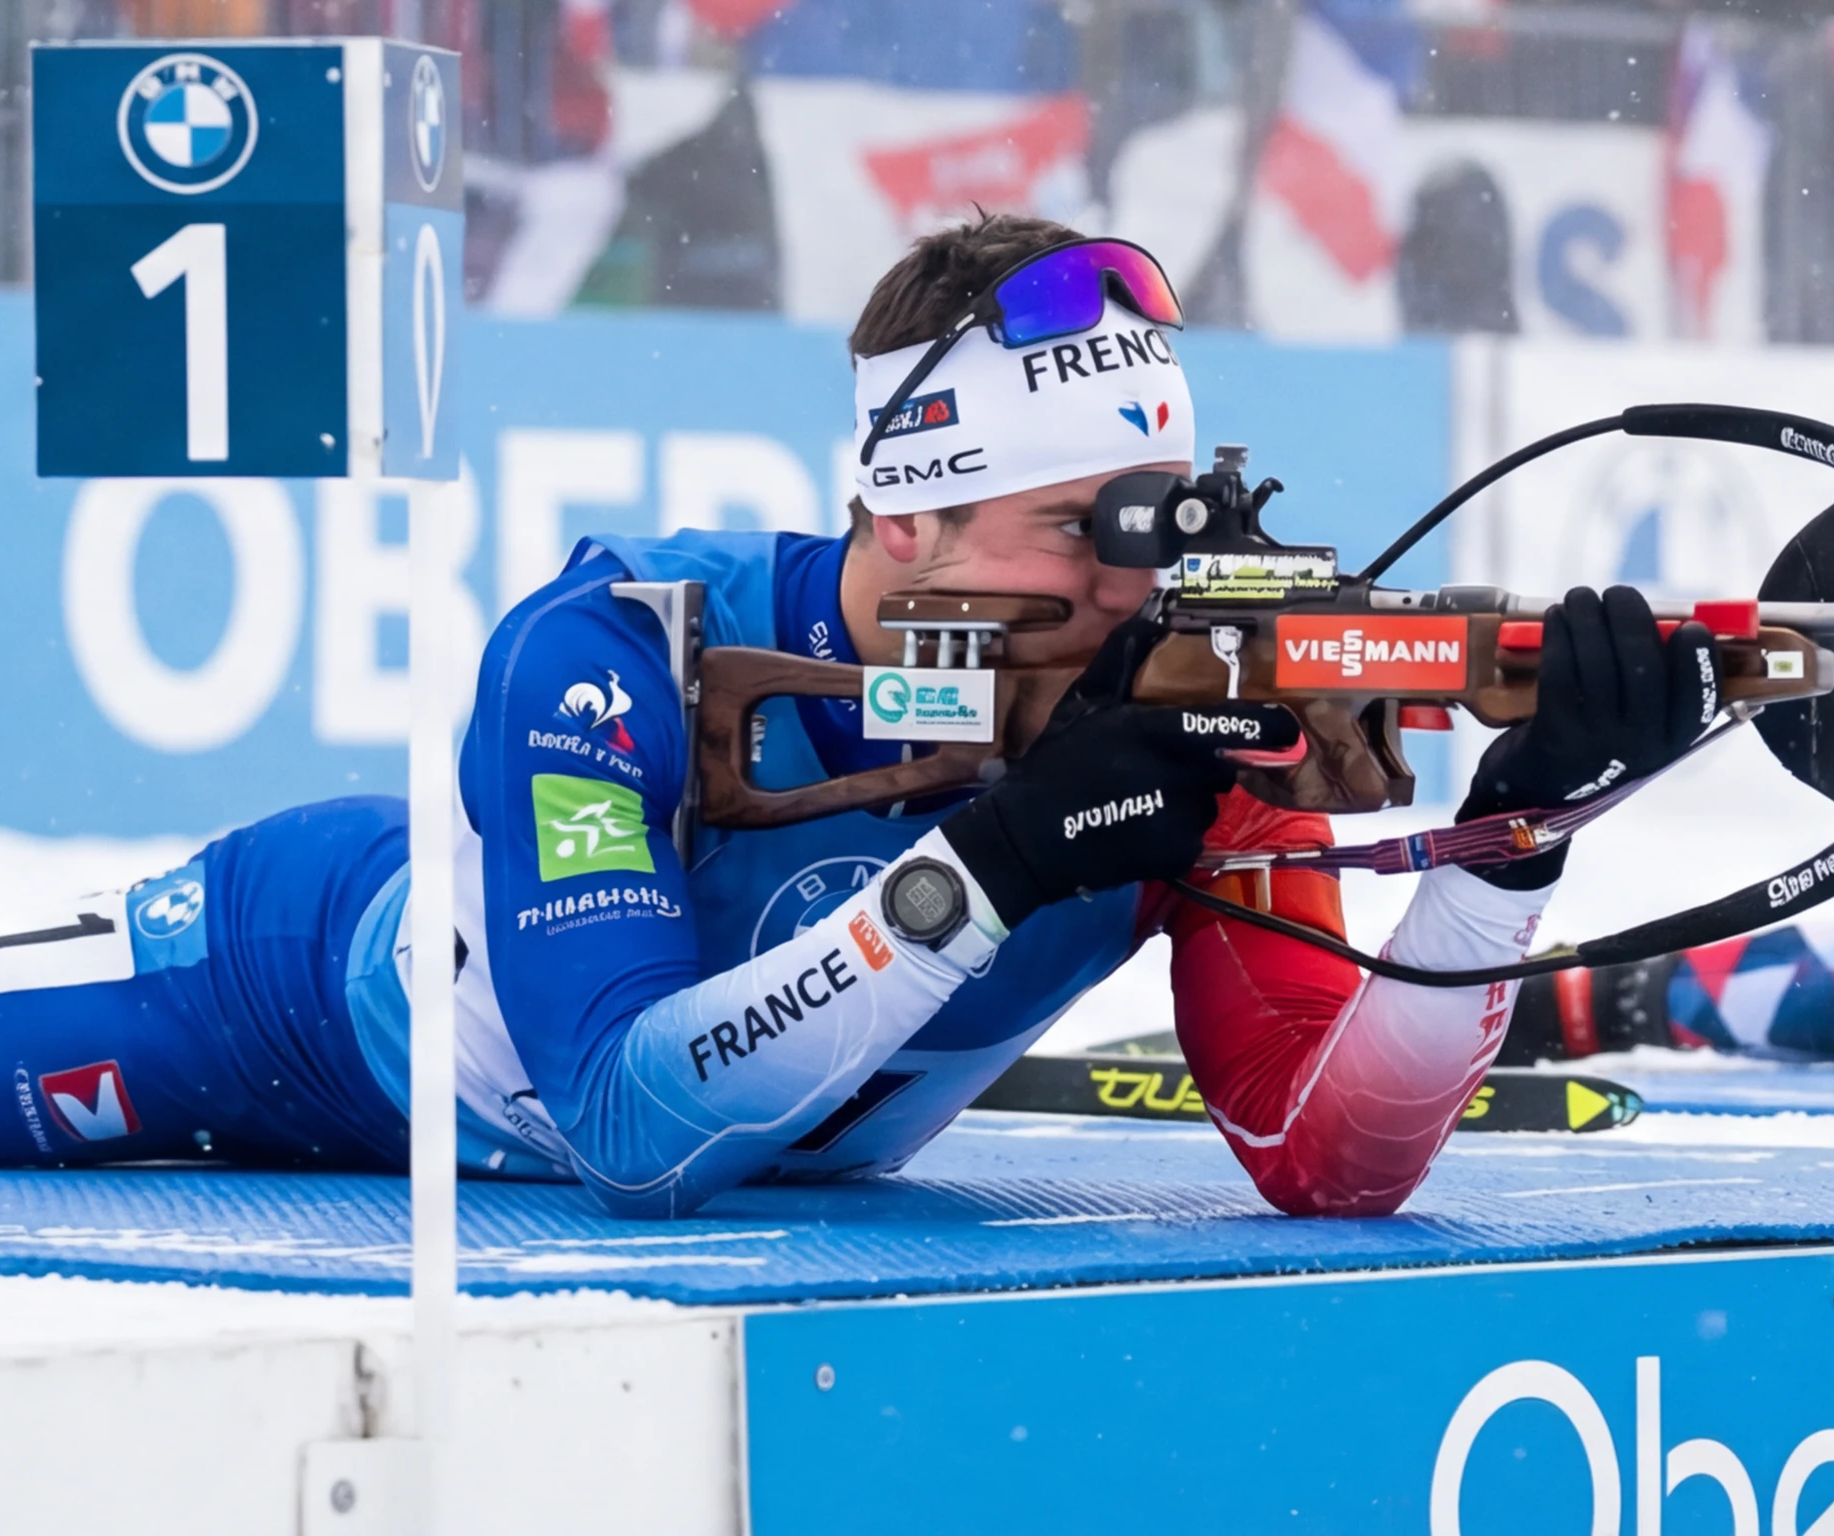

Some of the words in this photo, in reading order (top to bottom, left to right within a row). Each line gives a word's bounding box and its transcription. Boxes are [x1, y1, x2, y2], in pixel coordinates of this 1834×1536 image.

[130, 223, 229, 461] 1
[1022, 328, 1180, 393] FRENC
[872, 447, 988, 488] GMC
[688, 948, 858, 1082] FRANCE
